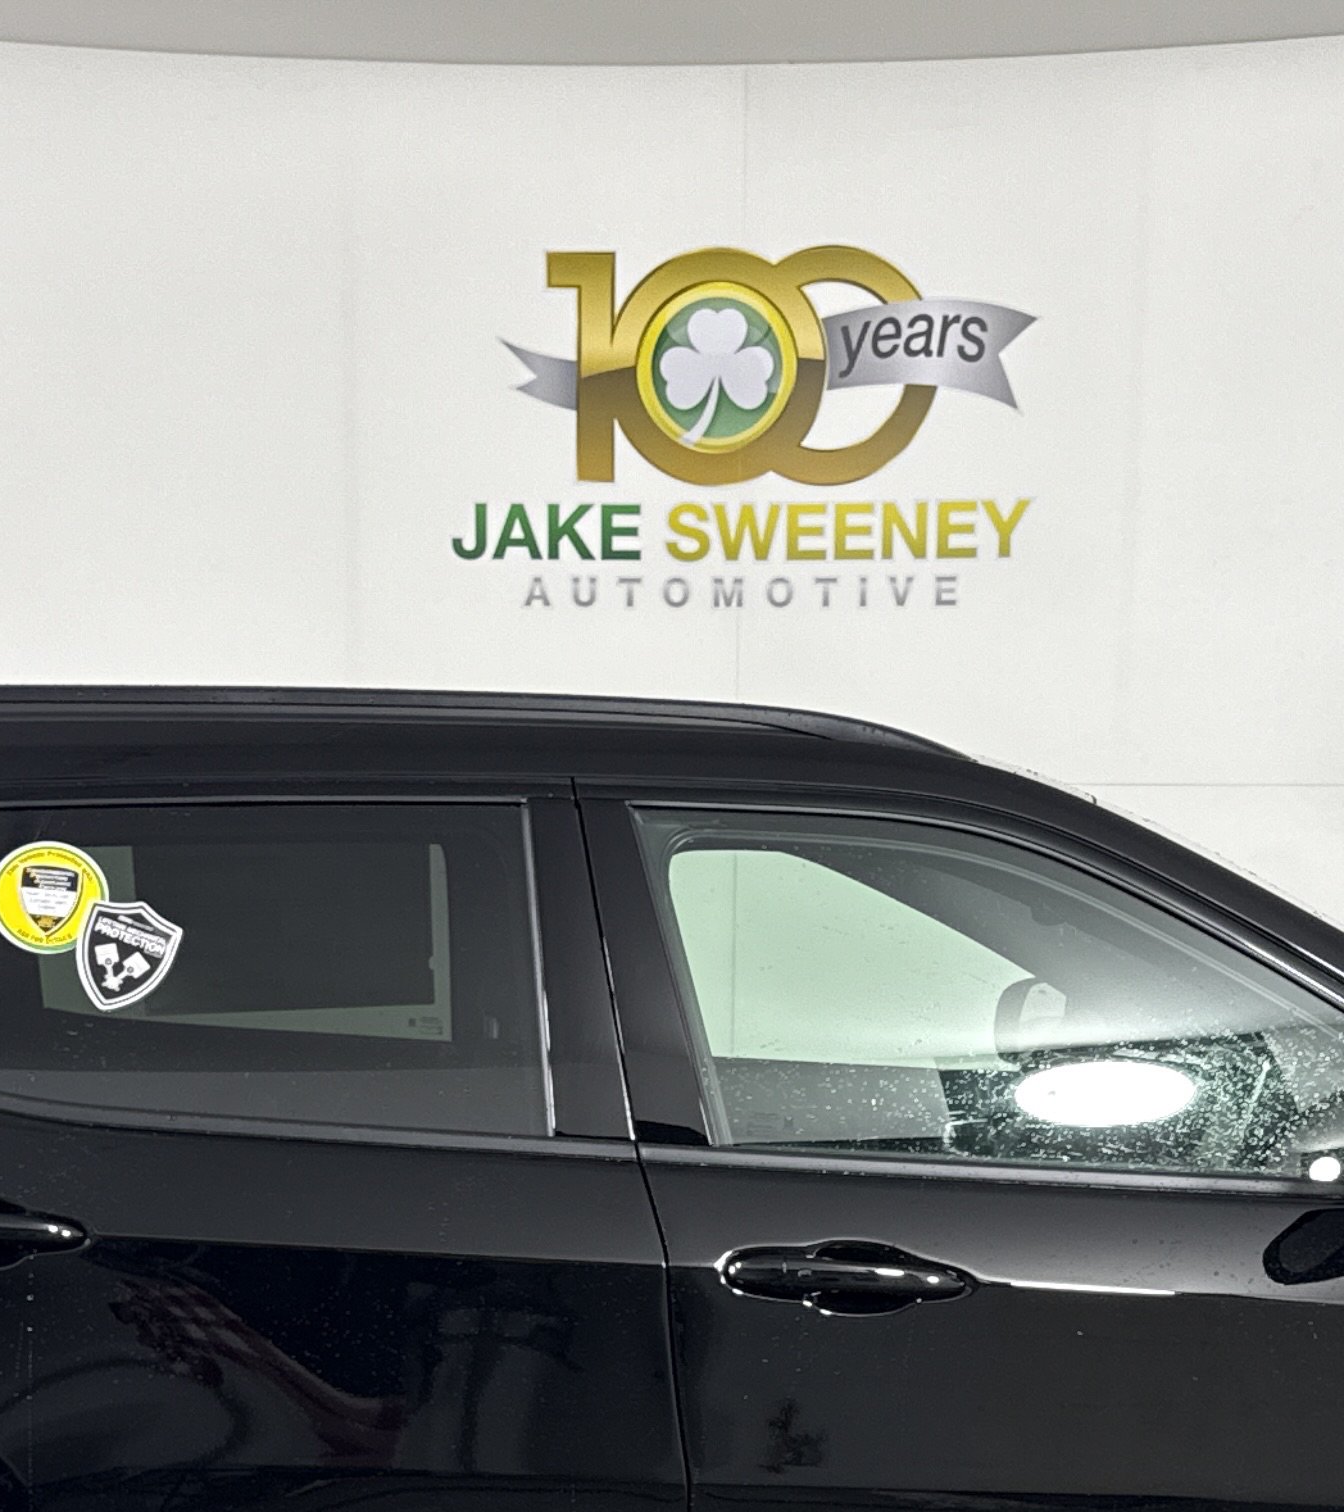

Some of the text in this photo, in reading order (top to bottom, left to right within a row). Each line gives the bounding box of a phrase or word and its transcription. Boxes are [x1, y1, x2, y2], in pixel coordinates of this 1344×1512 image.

[545, 244, 938, 487] 100
[837, 307, 989, 379] years
[451, 499, 1034, 562] JAKE SWEENEY
[523, 574, 959, 609] AUTOMOTIVE
[94, 921, 166, 957] PROTECTION
